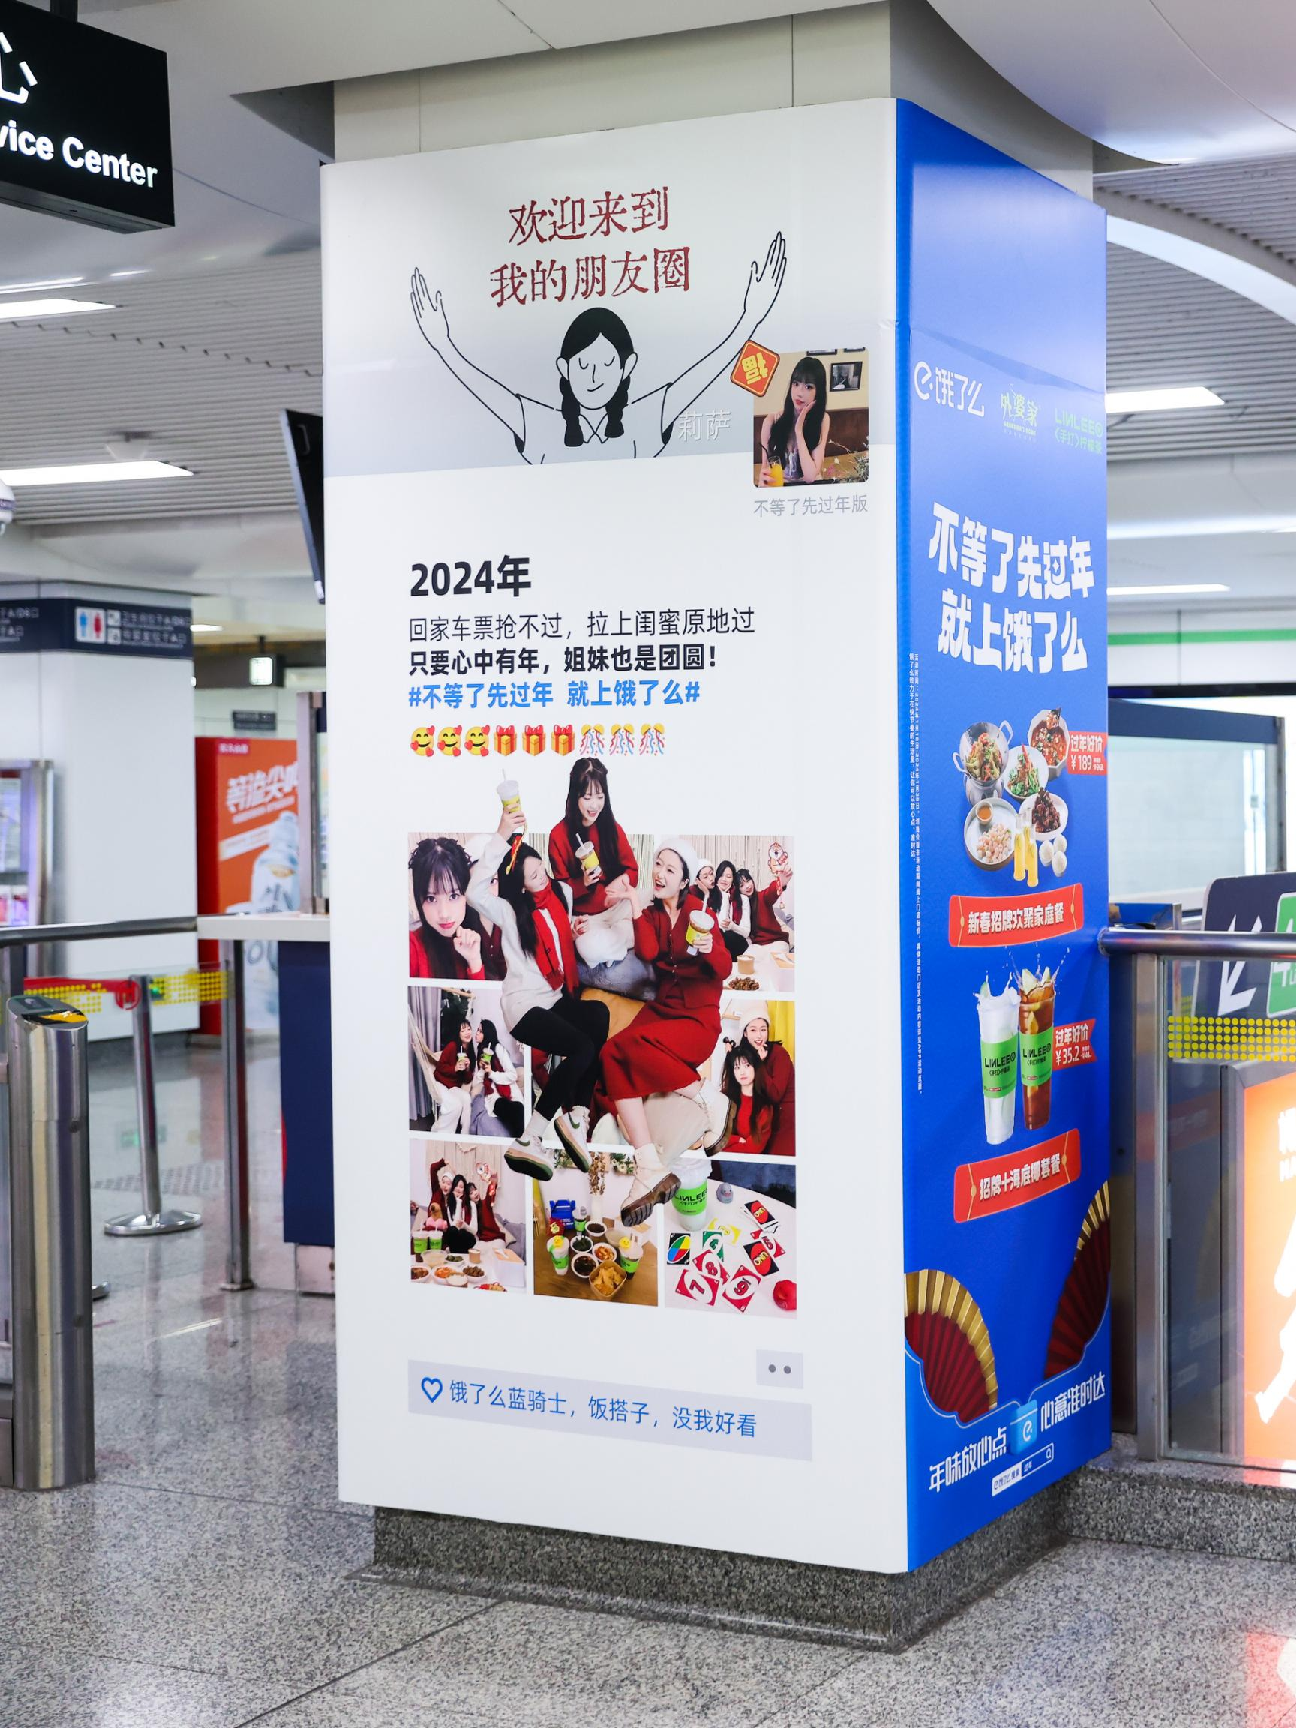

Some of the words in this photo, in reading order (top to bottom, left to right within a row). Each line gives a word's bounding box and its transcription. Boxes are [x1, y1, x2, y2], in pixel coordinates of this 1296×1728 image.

[62, 136, 158, 188] Center
[508, 186, 669, 246] 欢迎来到
[489, 246, 690, 308] 我的朋友圈
[678, 410, 731, 442] 莉萨
[753, 494, 869, 518] 不等了先过年版
[410, 555, 532, 598] 2024年
[928, 501, 1095, 600] 不等了先过年
[937, 587, 1089, 674] 就上饿了么
[408, 682, 553, 709] #不等了先过年
[567, 680, 700, 708] 就上饿了么#
[928, 1426, 1007, 1493] 年味放心点
[1040, 1370, 1106, 1433] 心意准时达
